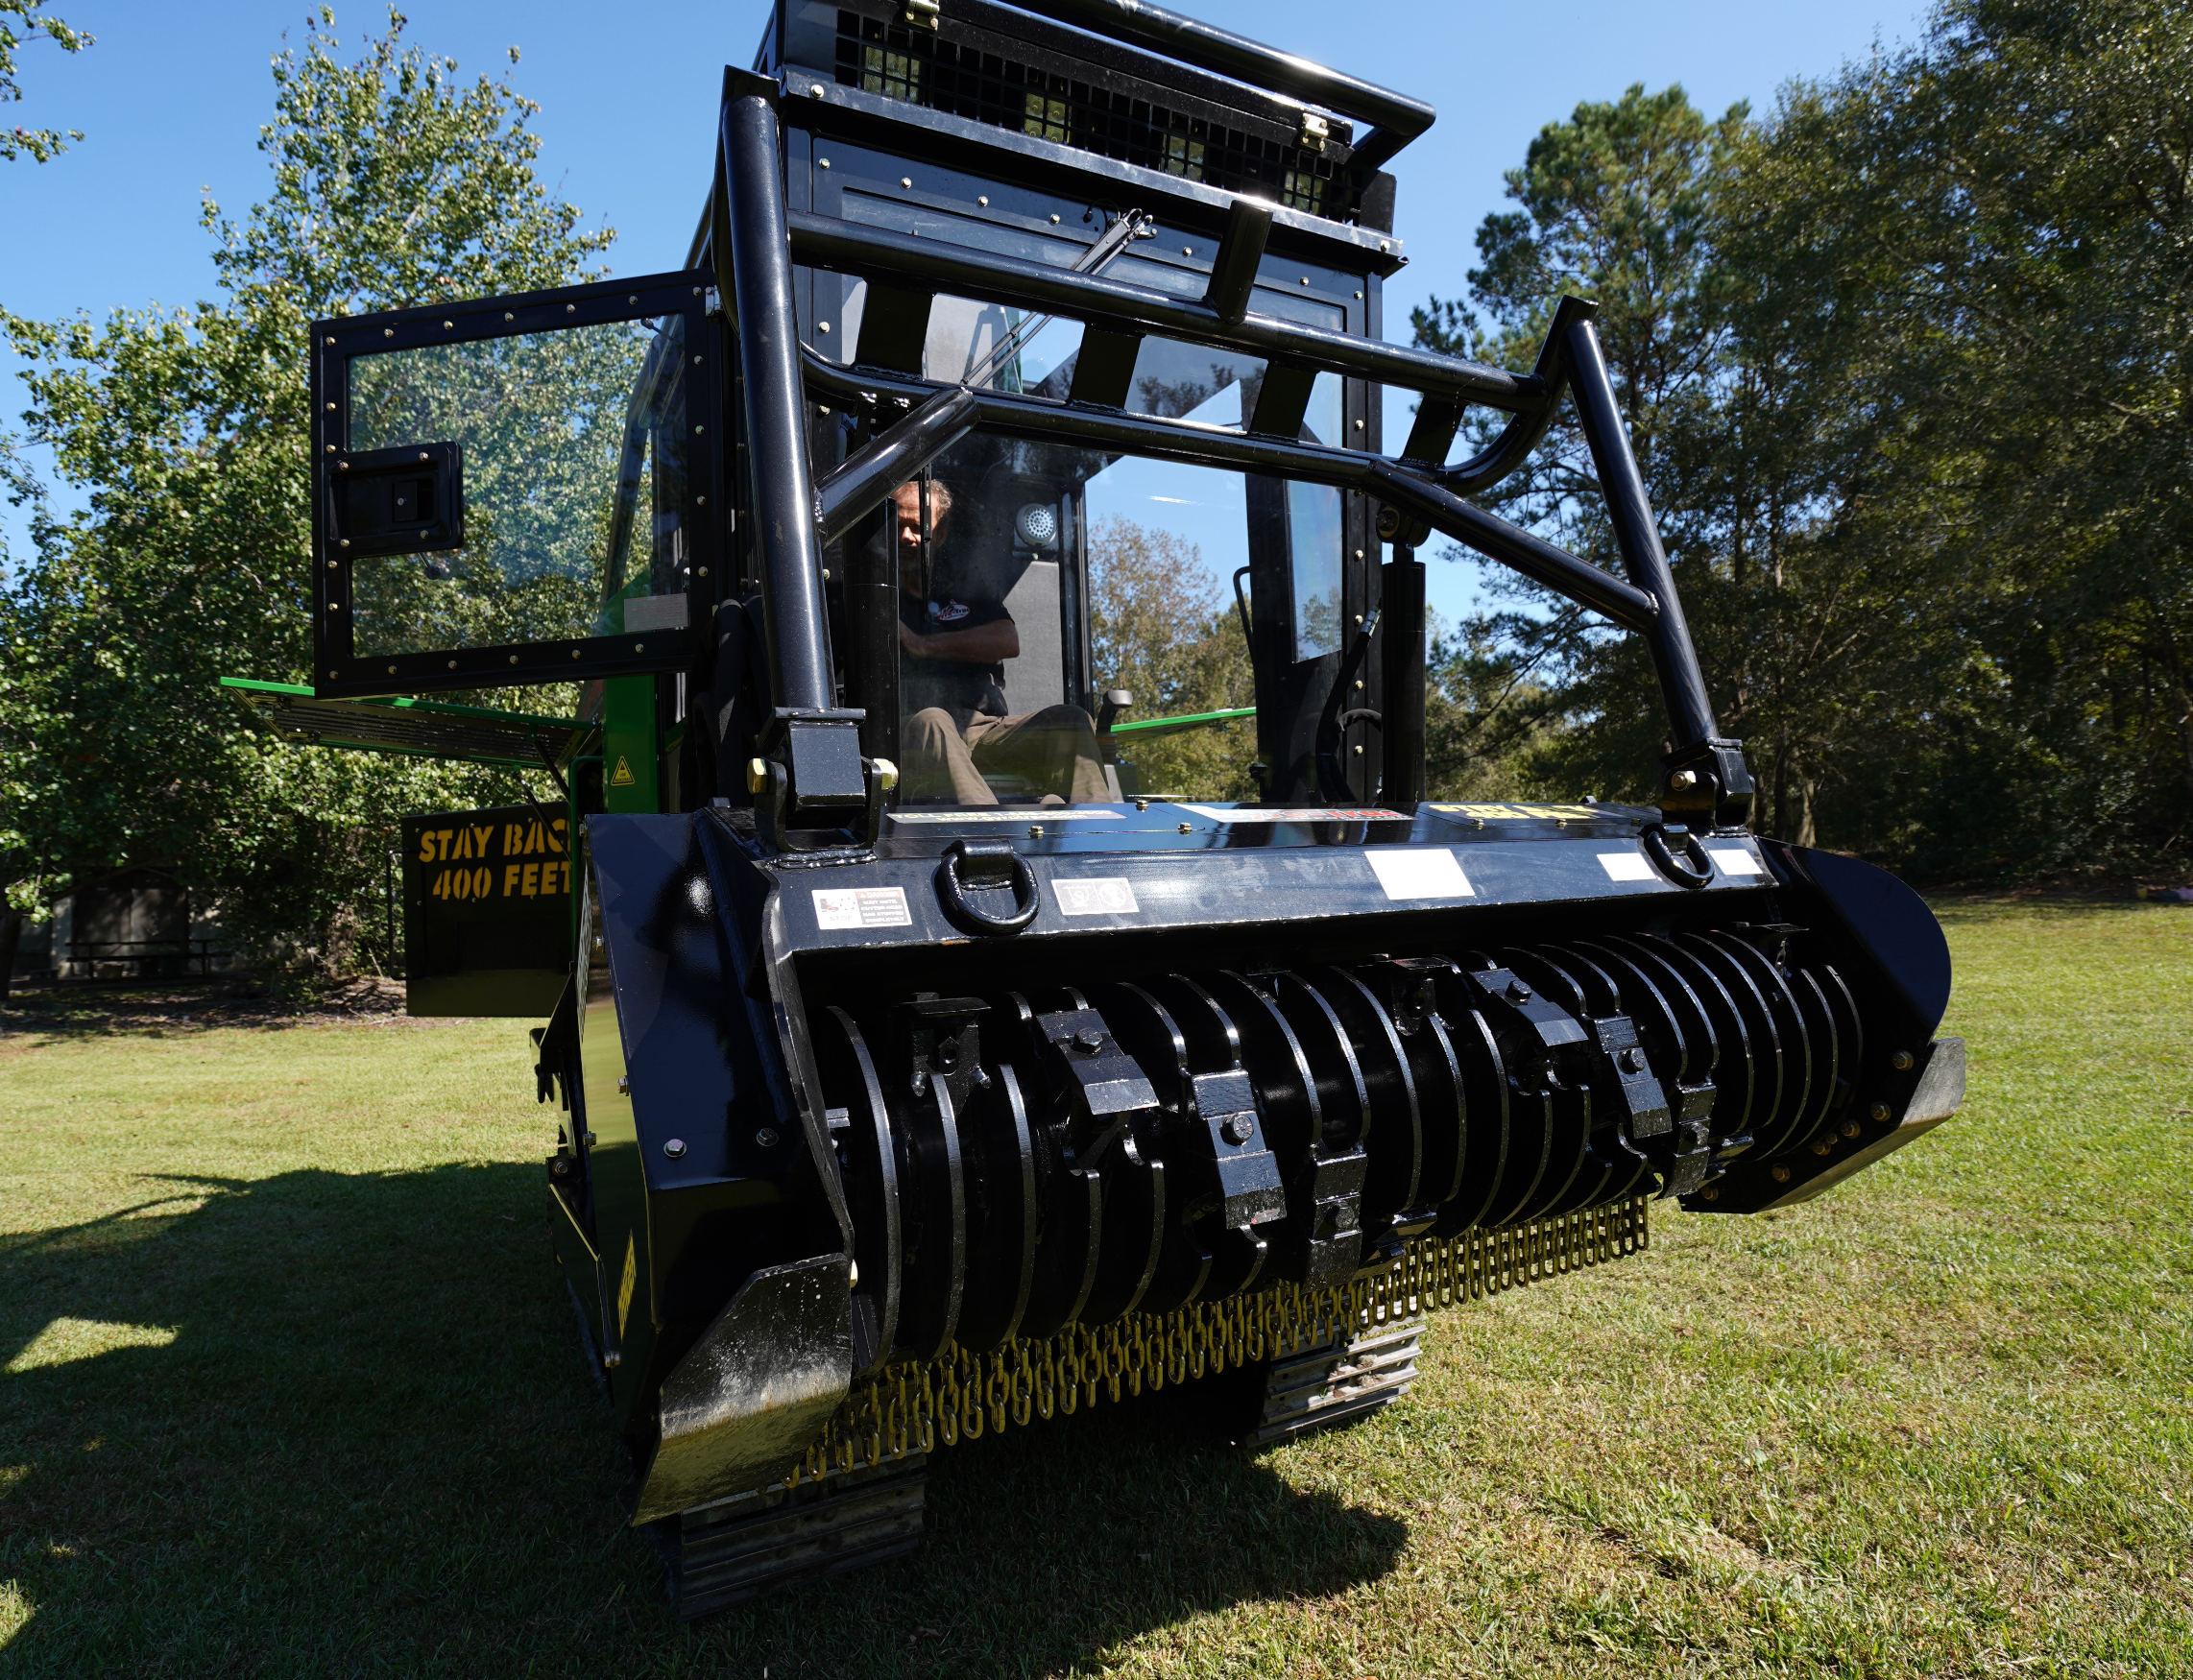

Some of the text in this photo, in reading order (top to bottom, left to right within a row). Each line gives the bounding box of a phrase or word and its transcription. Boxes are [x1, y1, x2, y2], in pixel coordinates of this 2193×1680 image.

[419, 819, 571, 862] STAY BAC
[432, 861, 571, 900] 400 FEET
